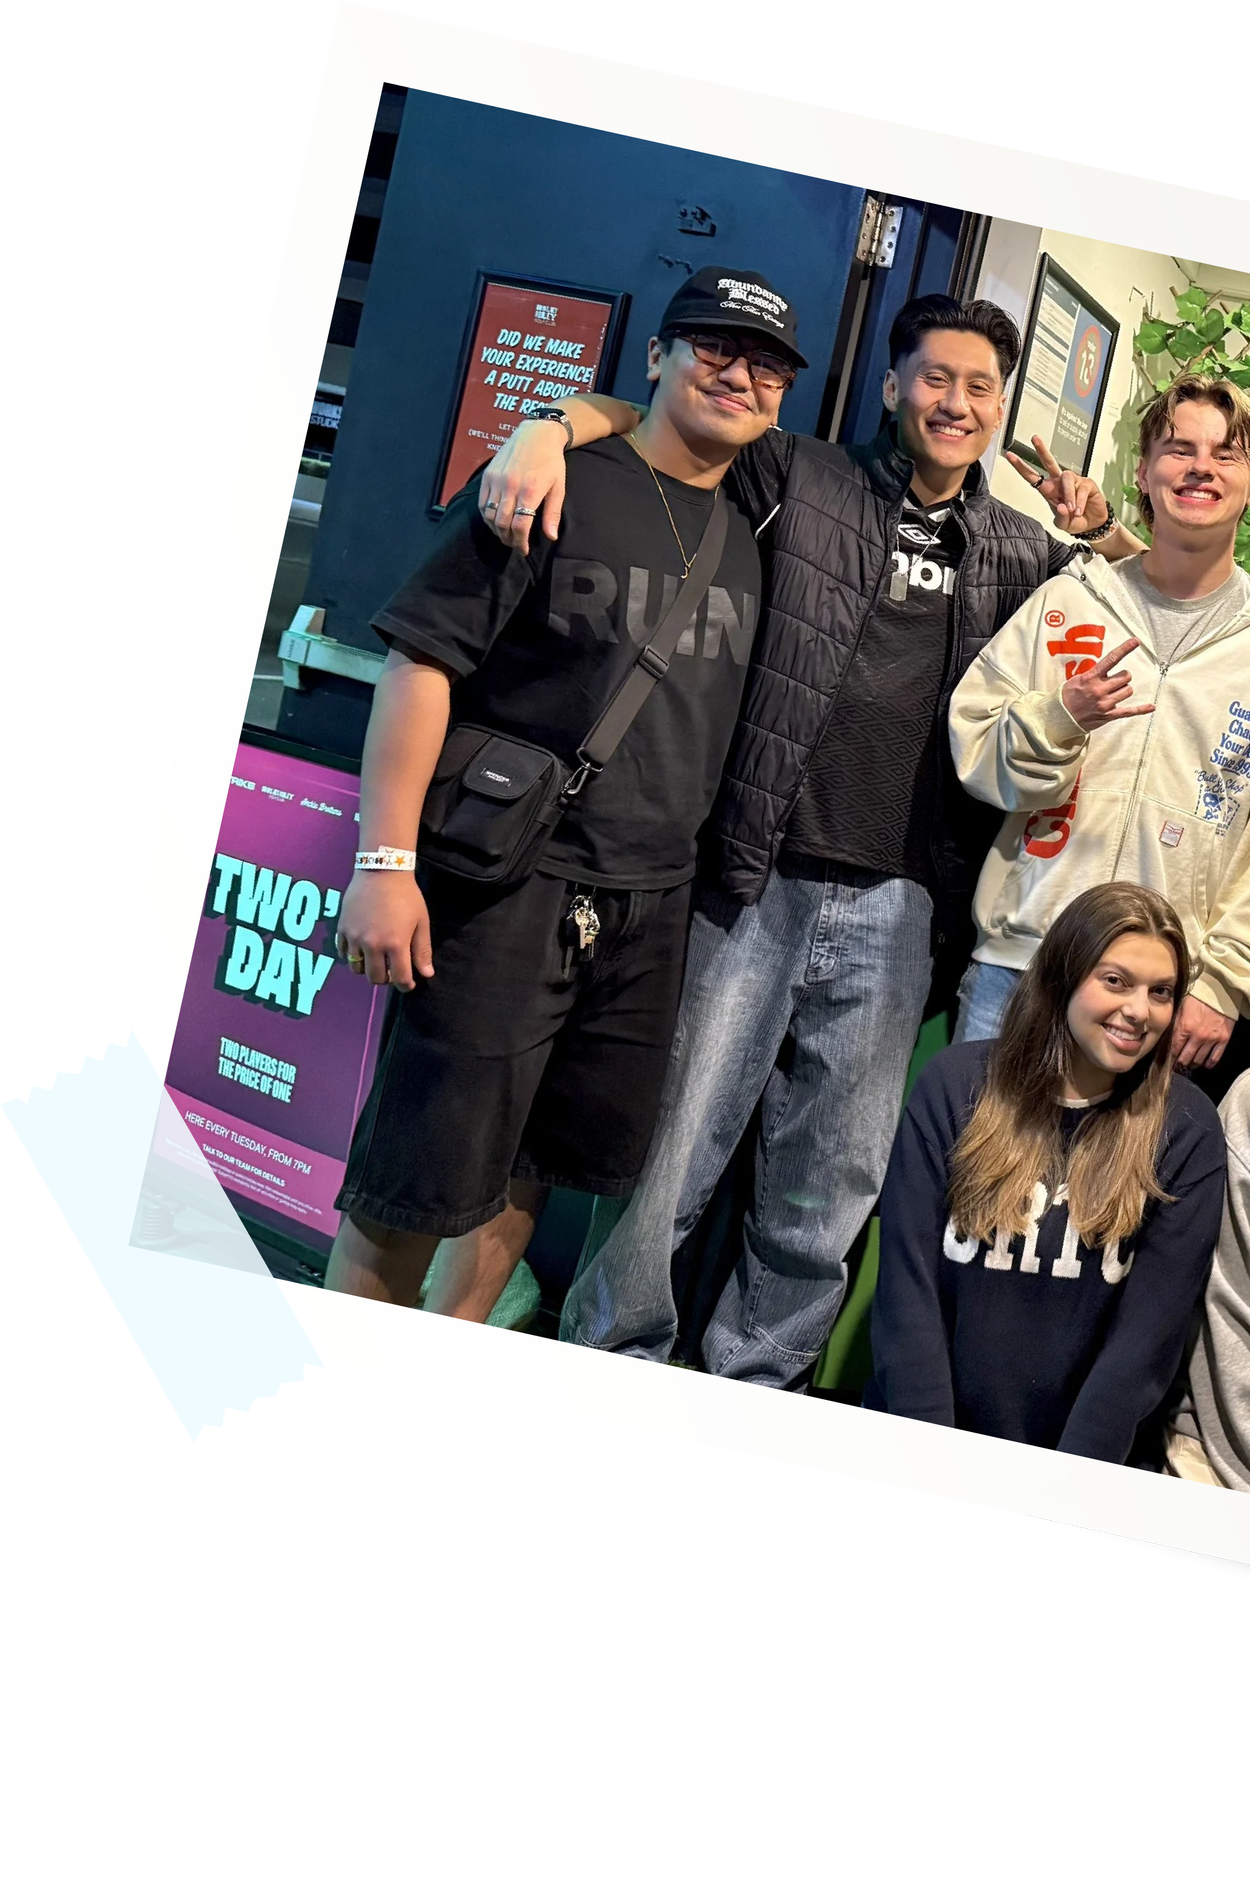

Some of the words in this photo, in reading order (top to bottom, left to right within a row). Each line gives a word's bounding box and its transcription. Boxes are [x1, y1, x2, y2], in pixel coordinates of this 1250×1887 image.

[728, 288, 780, 315] Blessed
[497, 328, 522, 348] DID
[522, 333, 545, 352] WE
[545, 338, 586, 360] MAKE
[480, 346, 515, 368] YOUR
[515, 354, 594, 384] EXPERIENCE
[484, 370, 498, 386] A
[497, 372, 534, 393] PUTT
[532, 379, 580, 400] ABOVE
[493, 392, 520, 412] THE
[491, 433, 509, 443] THIN
[1220, 732, 1244, 754] Your
[224, 925, 334, 1016] DAY
[220, 1036, 240, 1060] TWO
[239, 1044, 278, 1076] PLAYERS
[277, 1060, 297, 1084] FOR
[218, 1056, 236, 1079] THE
[234, 1063, 261, 1090] PRICE
[260, 1074, 273, 1095] OF
[272, 1080, 293, 1104] ONE
[184, 1110, 206, 1128] HERE
[205, 1120, 230, 1138] EVERY
[230, 1131, 267, 1158] TUESDAY,
[267, 1148, 292, 1168] FROM
[292, 1158, 312, 1175] 7PM
[202, 1143, 216, 1156] TALK
[216, 1149, 224, 1159] TO
[223, 1153, 236, 1164] OUR
[235, 1158, 251, 1172] TEAM
[250, 1166, 263, 1177] FOR
[262, 1172, 286, 1187] DETAILS
